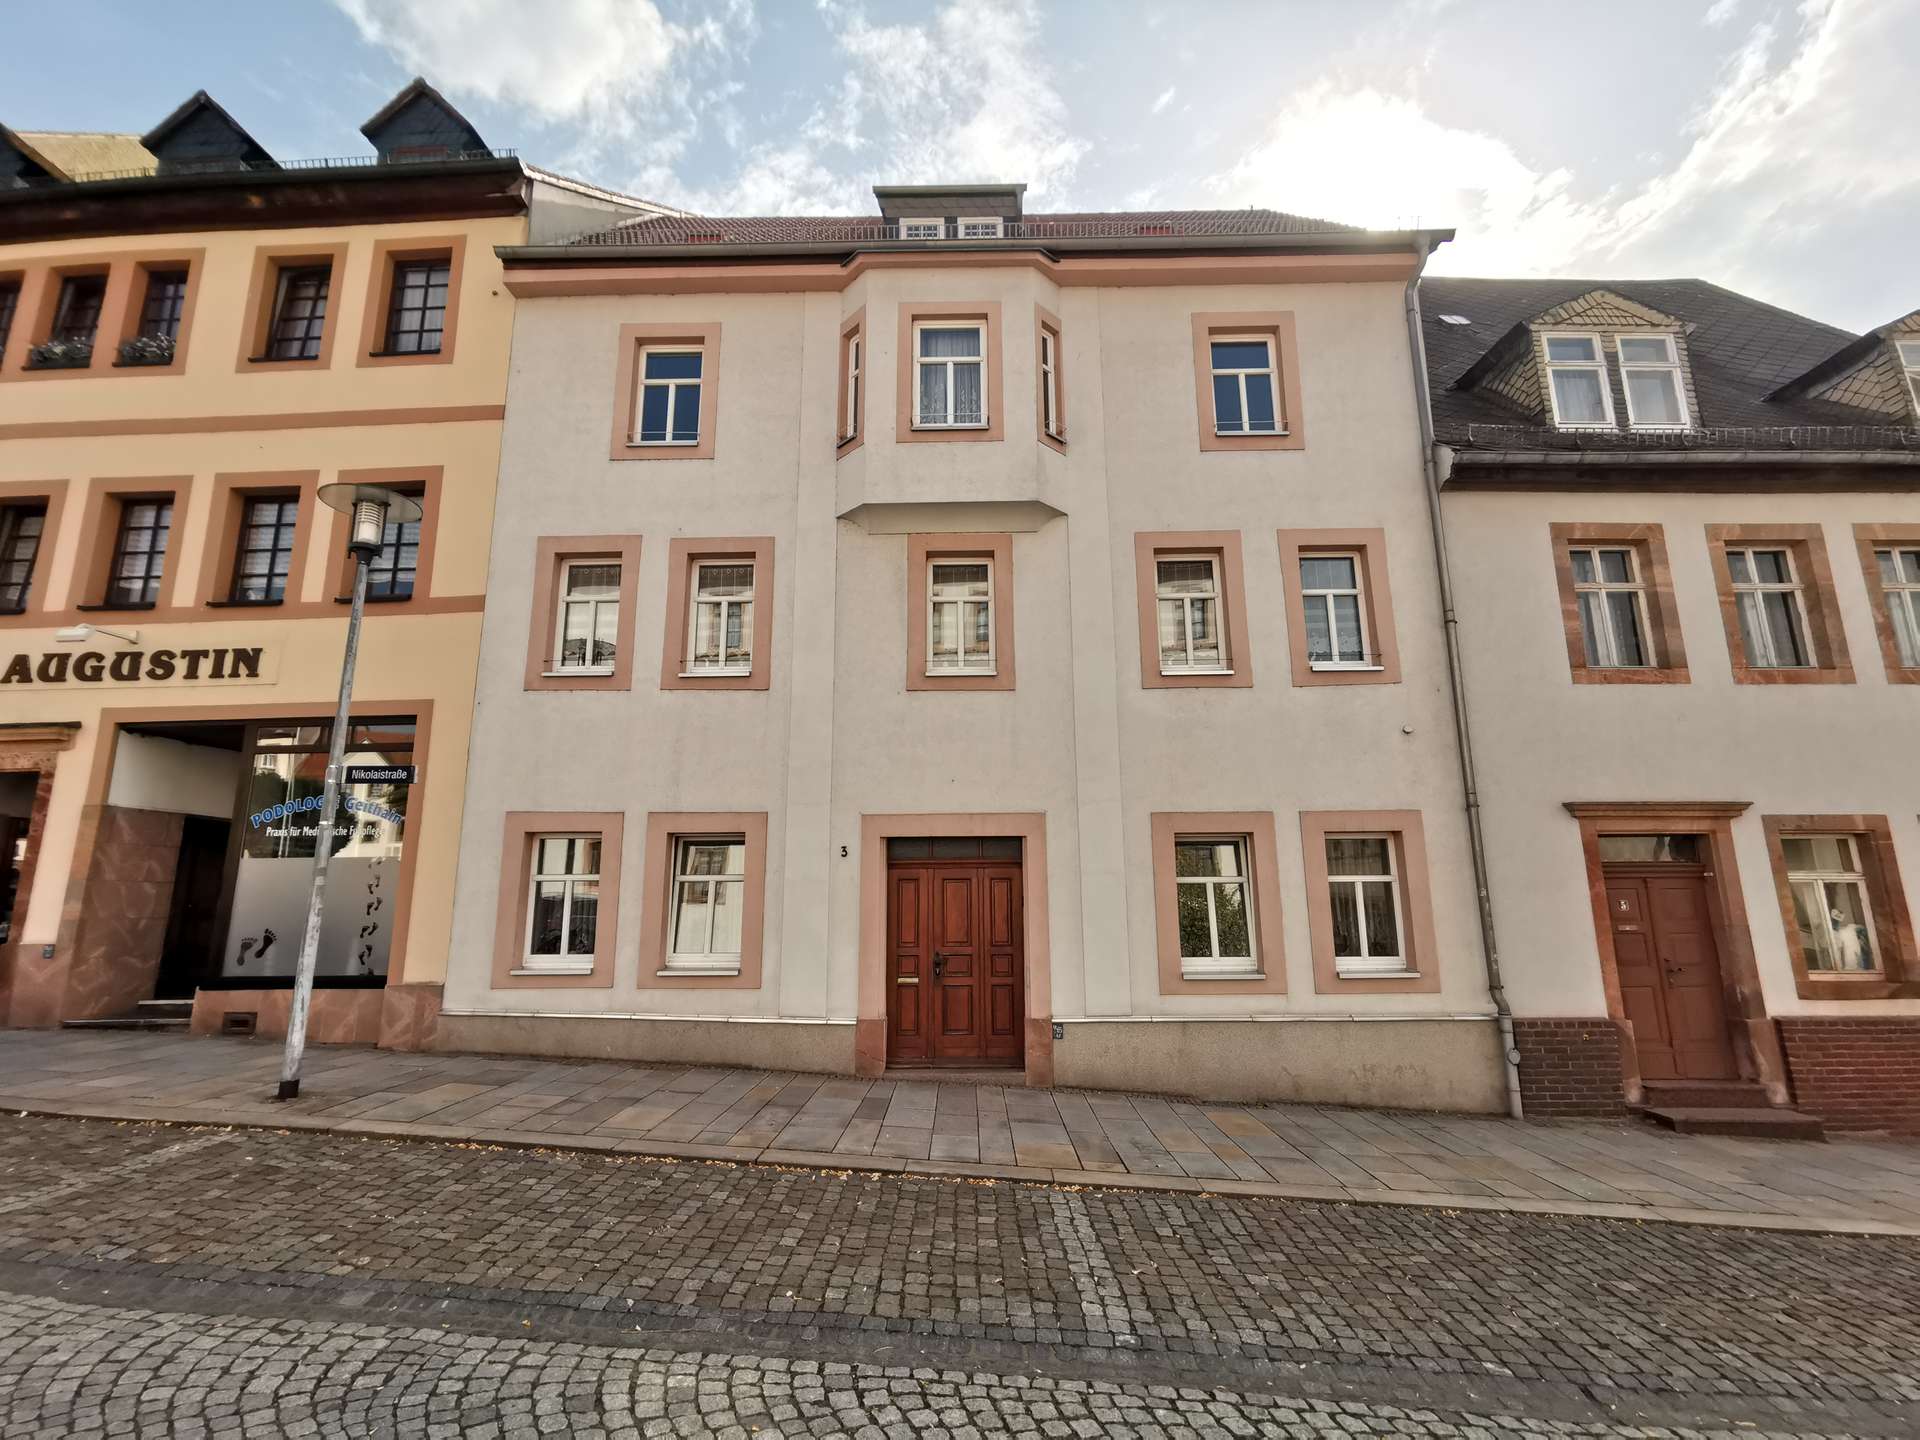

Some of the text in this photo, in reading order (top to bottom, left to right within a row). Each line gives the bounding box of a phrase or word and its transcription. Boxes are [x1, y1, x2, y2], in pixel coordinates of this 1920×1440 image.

[0, 648, 263, 684] AUGUSTIN
[351, 769, 407, 780] Nikolaistraße
[251, 794, 340, 829] PODOLOG
[265, 826, 288, 837] Praxis
[840, 845, 848, 858] 3
